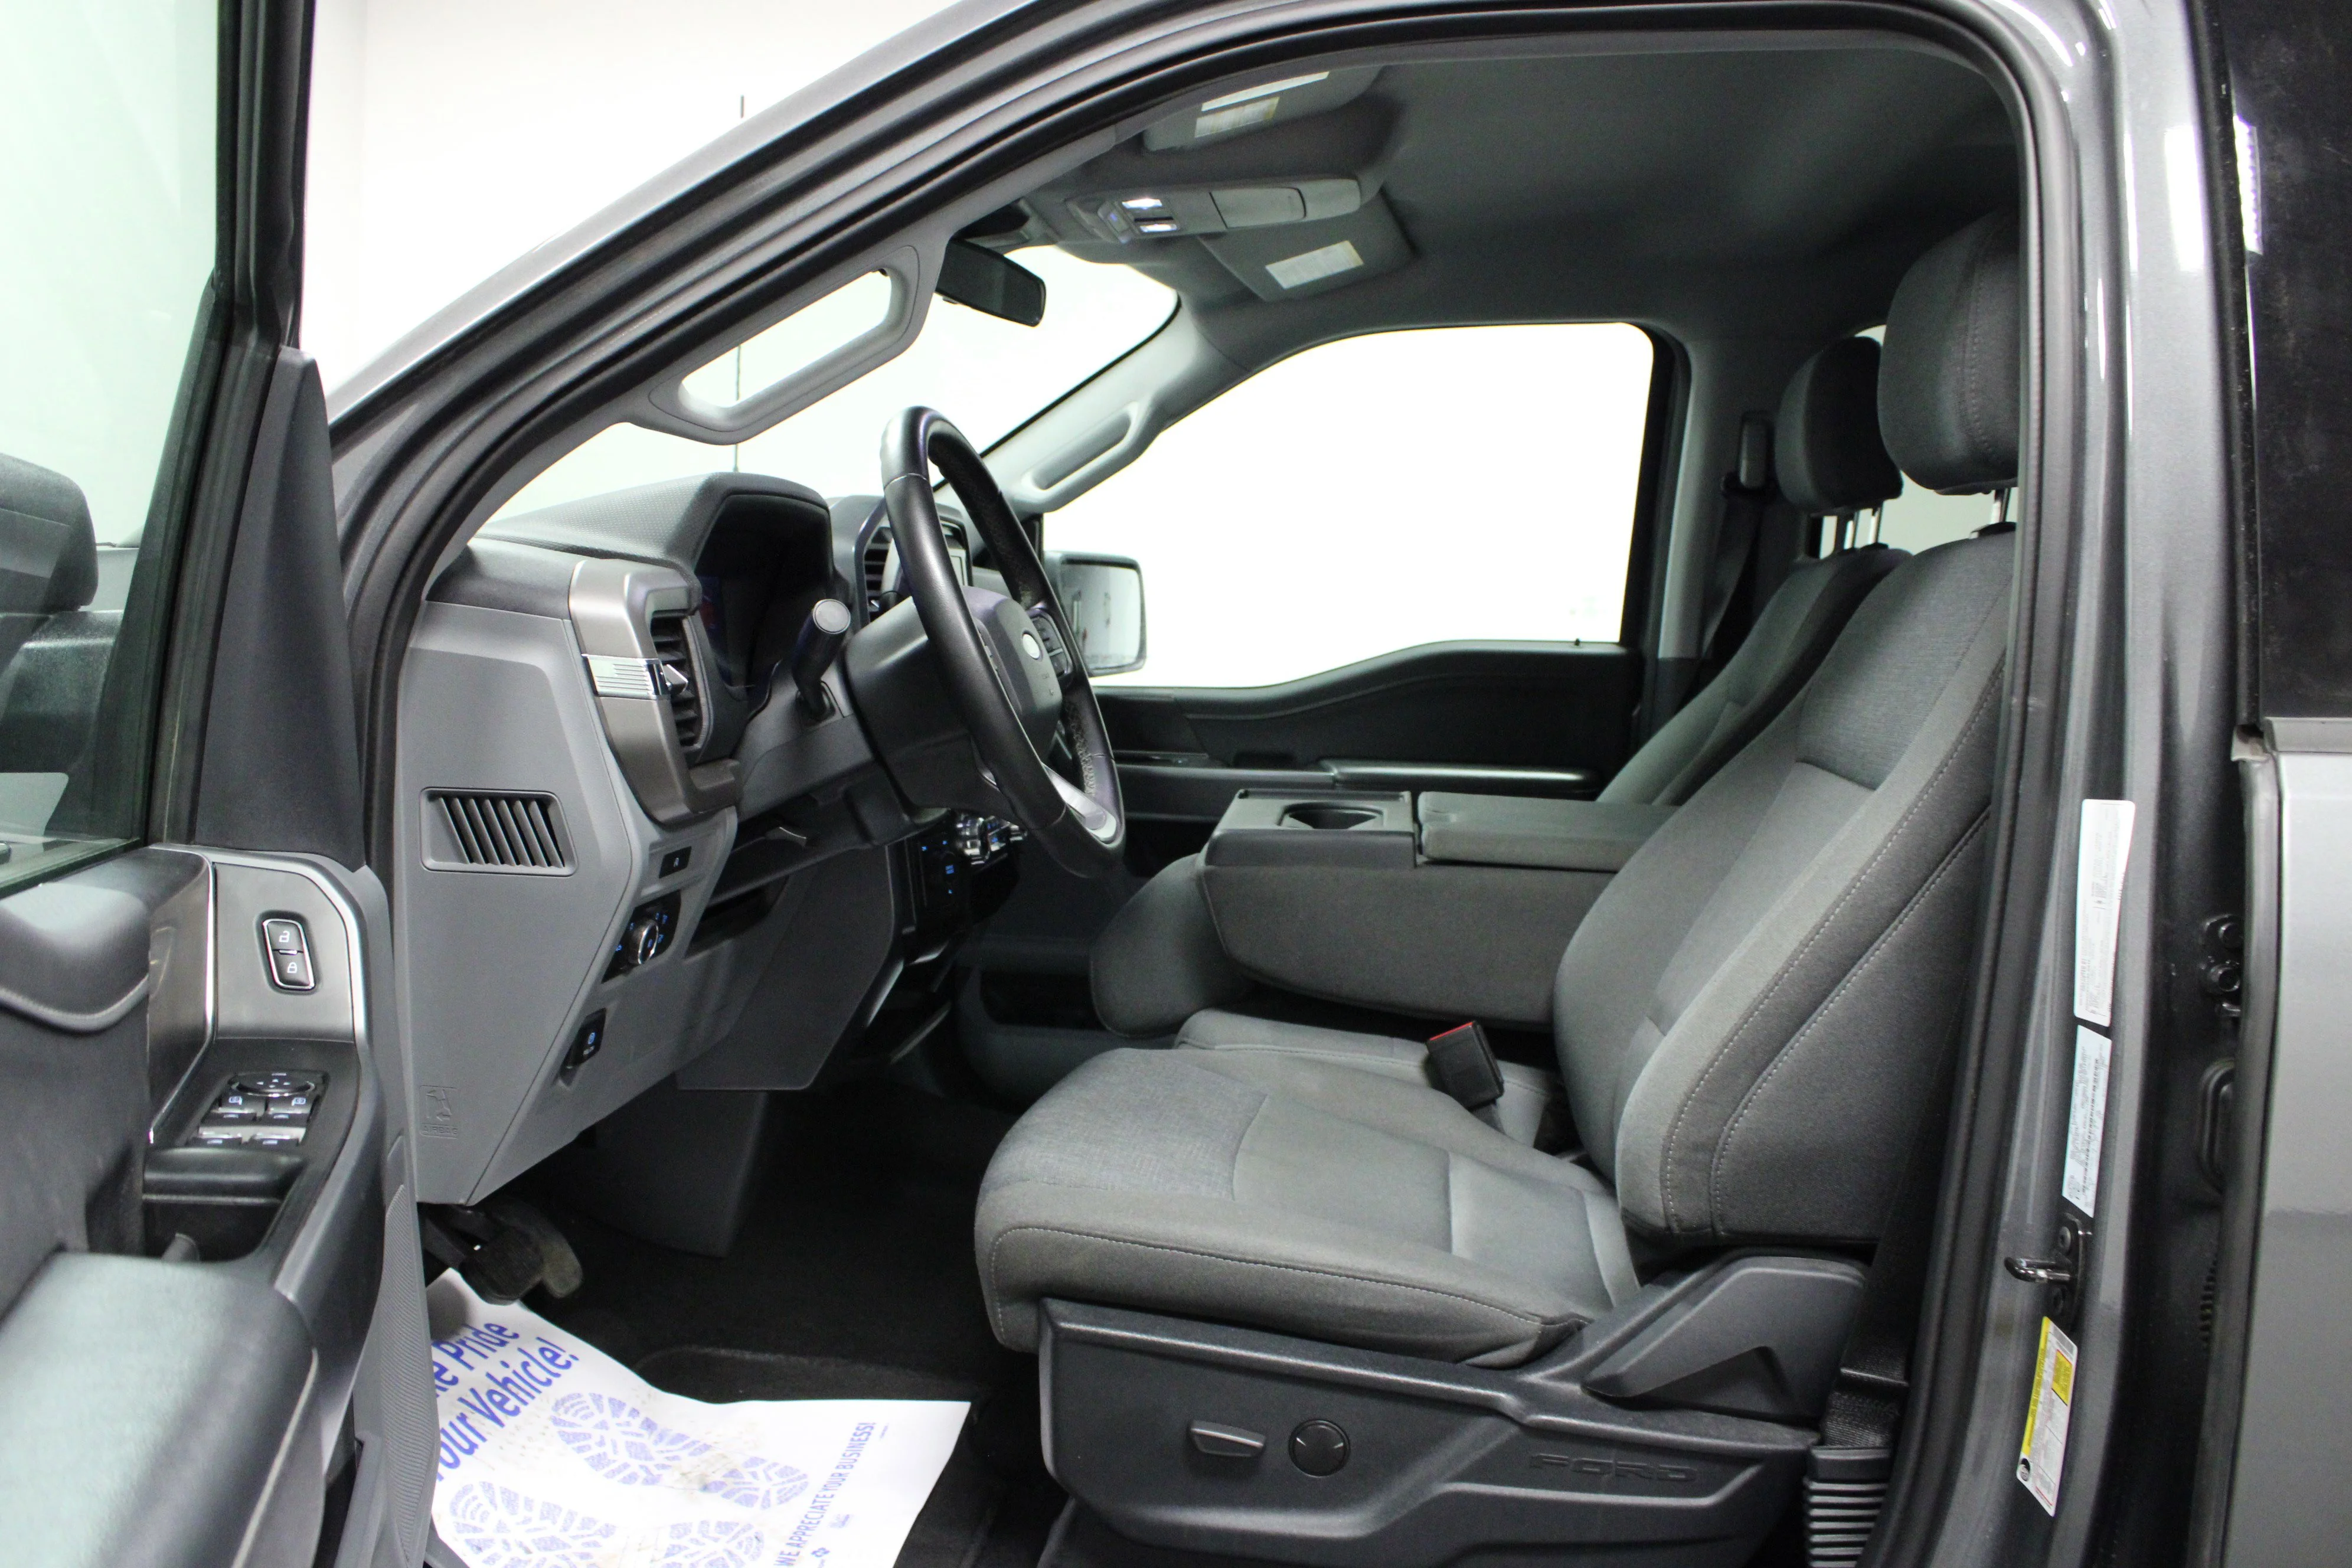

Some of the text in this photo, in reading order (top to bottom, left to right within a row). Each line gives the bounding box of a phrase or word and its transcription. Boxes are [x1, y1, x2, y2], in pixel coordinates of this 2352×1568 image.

[432, 1322, 520, 1371] Pride
[437, 1337, 580, 1481] our Vehicle!
[835, 1423, 876, 1469] BUSINESS!
[1531, 1453, 1698, 1481] FORD
[818, 1472, 850, 1492] YOUR
[786, 1494, 835, 1548] APPRECIATE
[773, 1551, 801, 1566] WE
